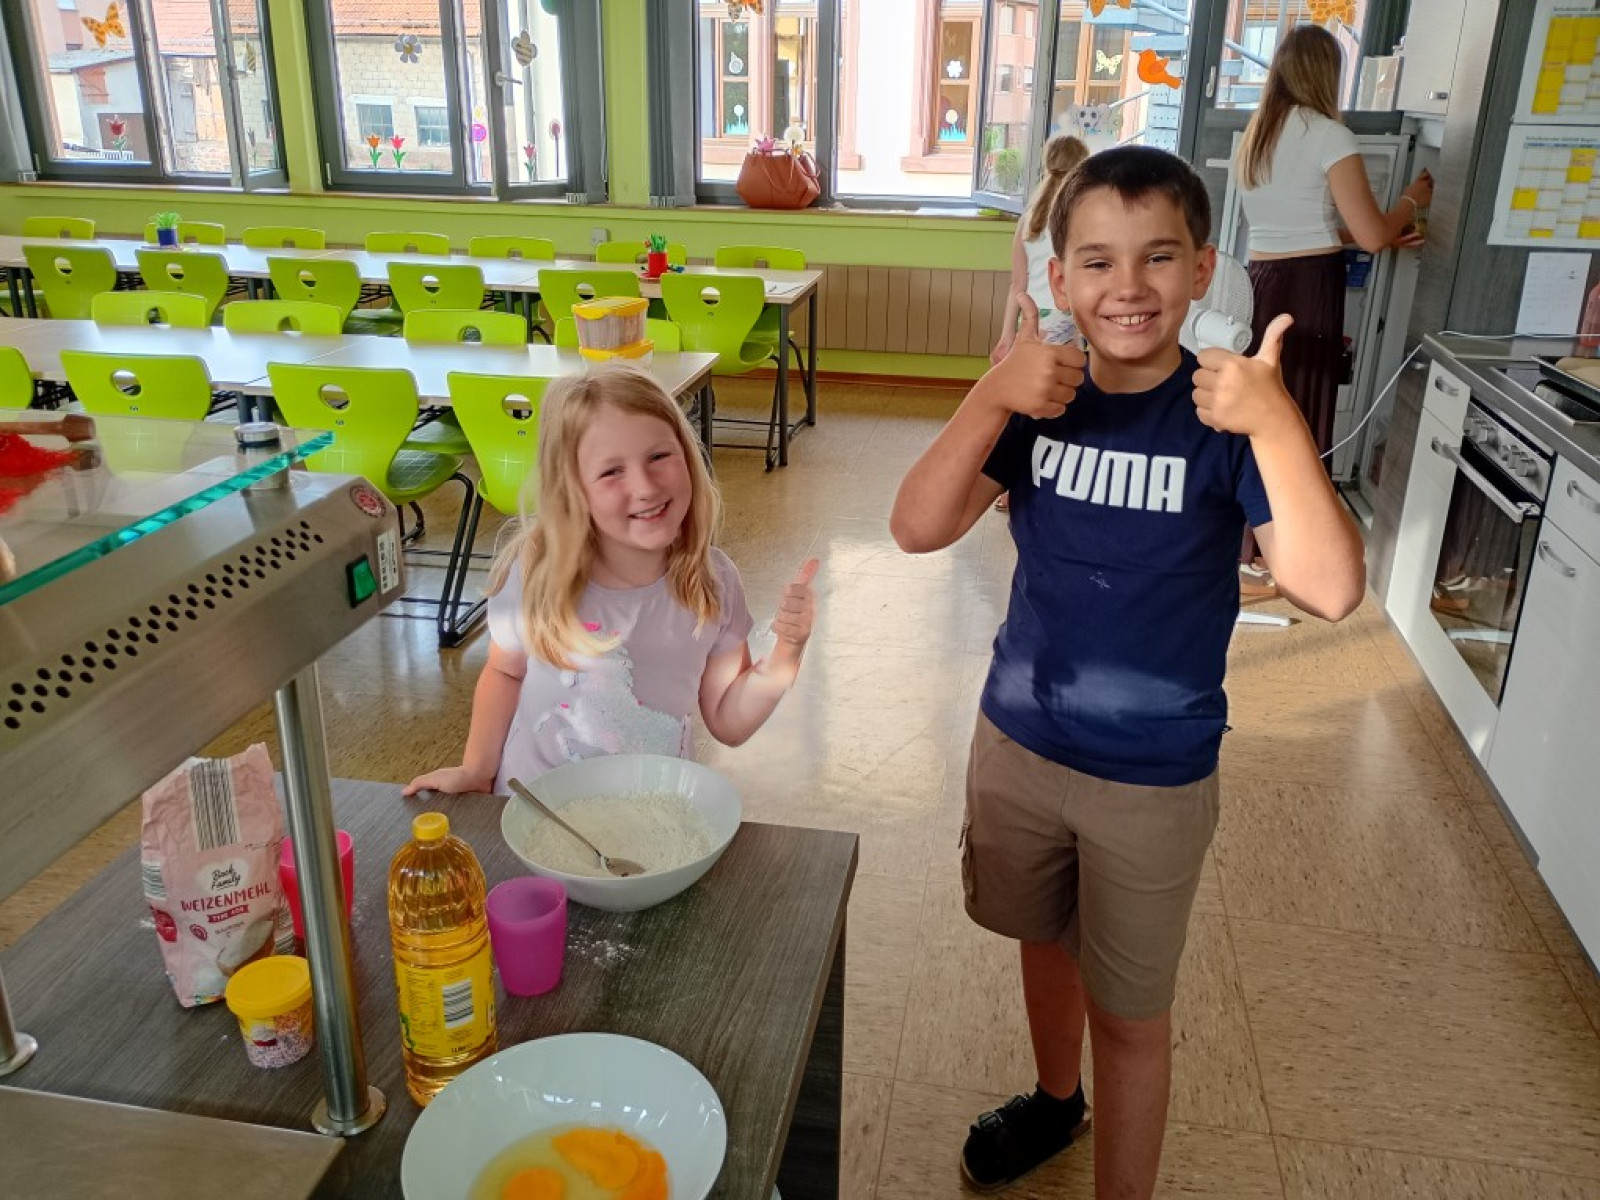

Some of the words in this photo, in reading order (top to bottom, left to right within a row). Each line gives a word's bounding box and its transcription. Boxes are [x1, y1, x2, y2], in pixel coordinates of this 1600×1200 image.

[1031, 435, 1187, 514] PUMA
[211, 864, 235, 881] Back
[211, 874, 241, 890] Family
[180, 882, 271, 912] WEIZENMEHL
